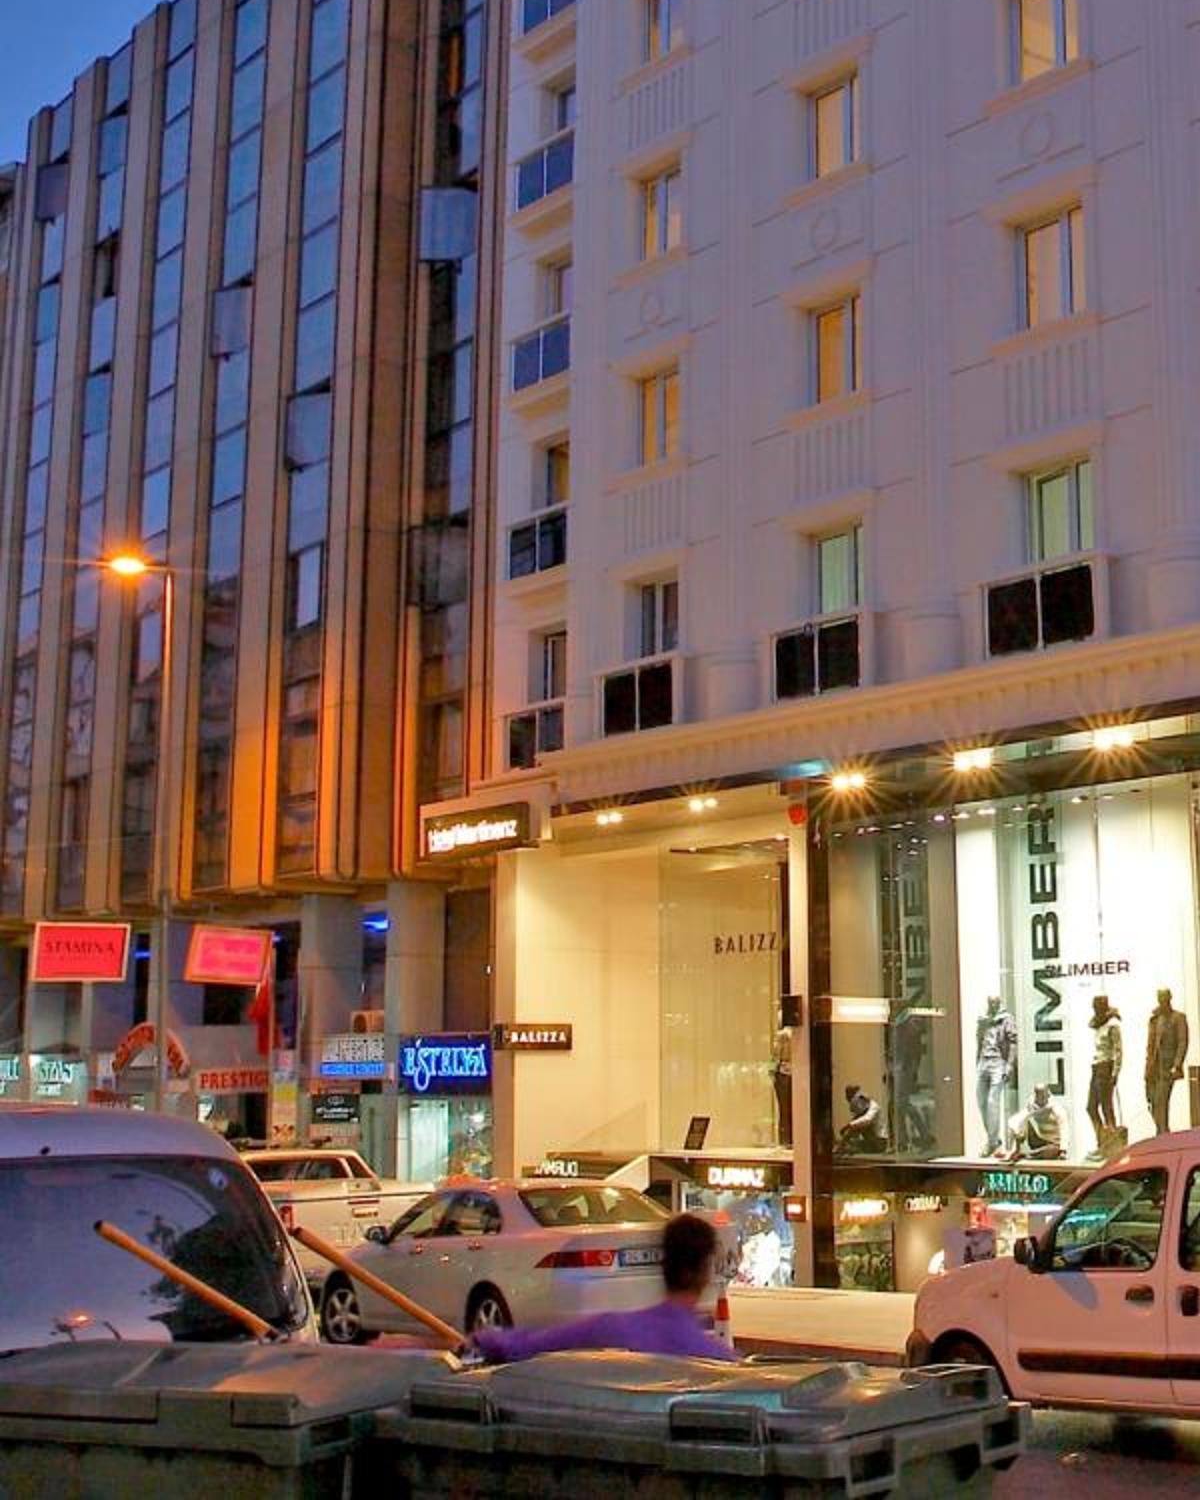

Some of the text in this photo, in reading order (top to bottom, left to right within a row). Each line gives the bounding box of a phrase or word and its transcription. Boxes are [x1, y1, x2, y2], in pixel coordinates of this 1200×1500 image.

[714, 931, 777, 956] BALIZZ
[1026, 802, 1066, 1097] LIMBER
[510, 1030, 568, 1044] BALIZZA
[200, 1069, 270, 1090] PRESTIG
